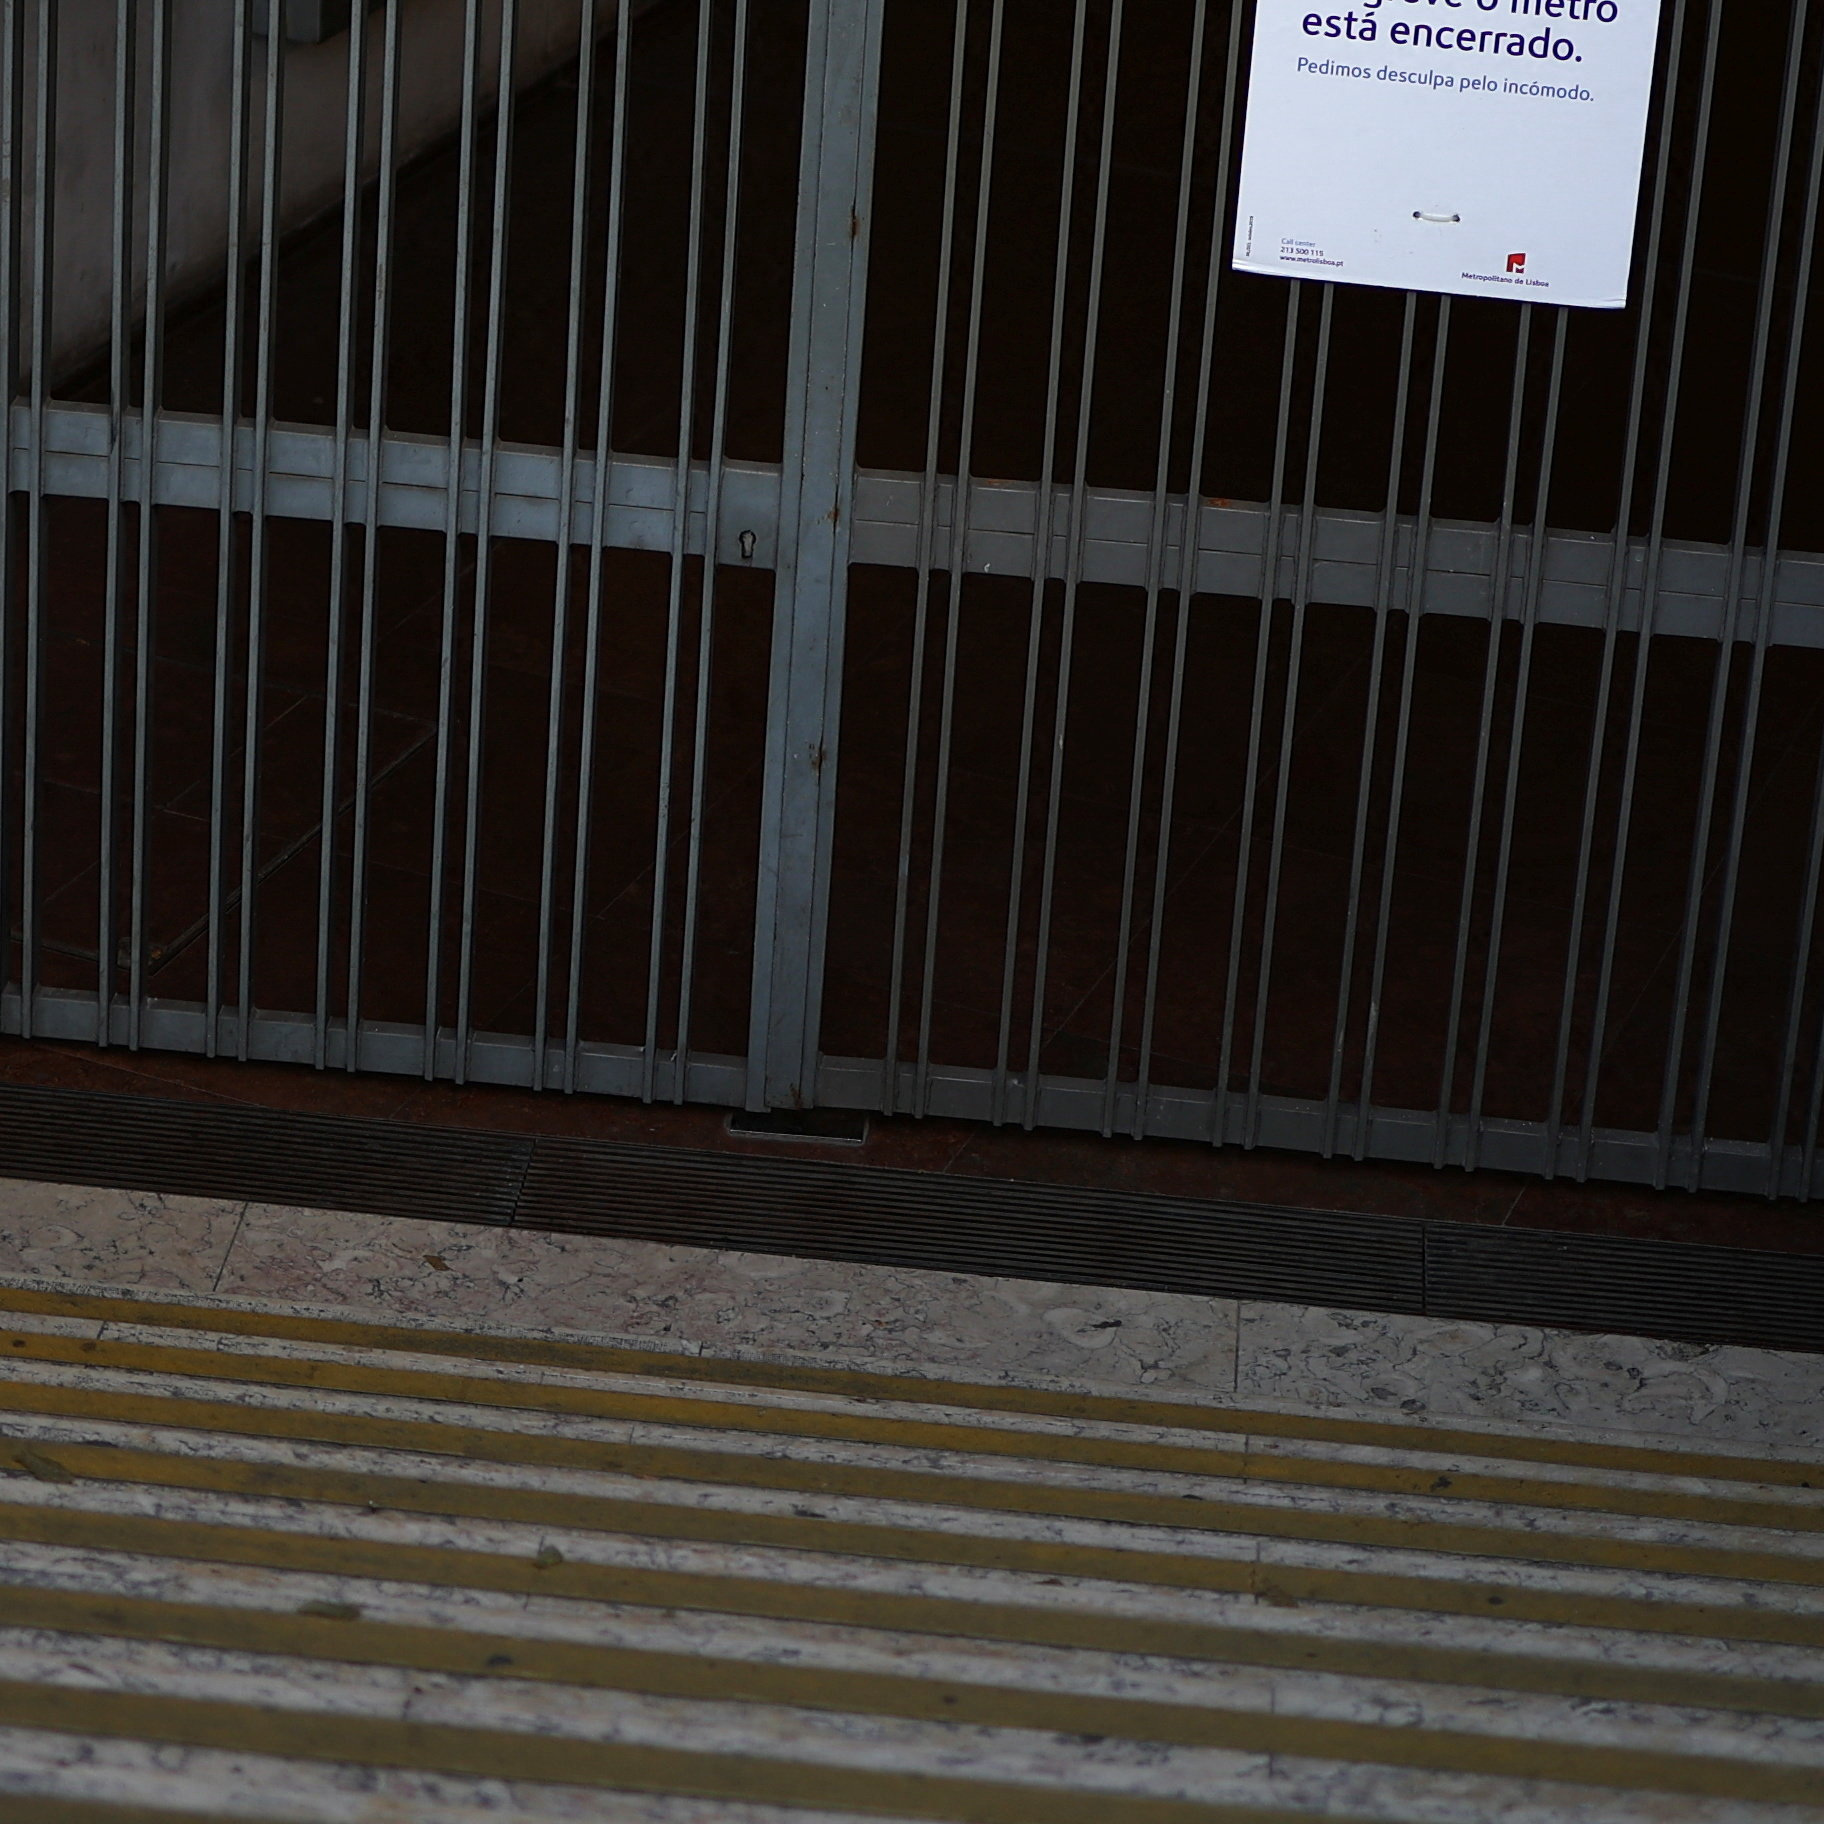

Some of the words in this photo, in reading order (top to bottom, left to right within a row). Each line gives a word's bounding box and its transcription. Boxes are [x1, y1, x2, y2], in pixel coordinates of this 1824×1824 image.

[1302, 11, 1377, 42] está
[1390, 21, 1583, 63] encerrado.
[1297, 57, 1371, 79] Pedimos
[1376, 65, 1454, 90] desculpa
[1459, 75, 1498, 92] pelo
[1503, 78, 1595, 102] incómodo.
[1461, 272, 1513, 284] Metropolitano
[1525, 279, 1549, 287] Lisboa
